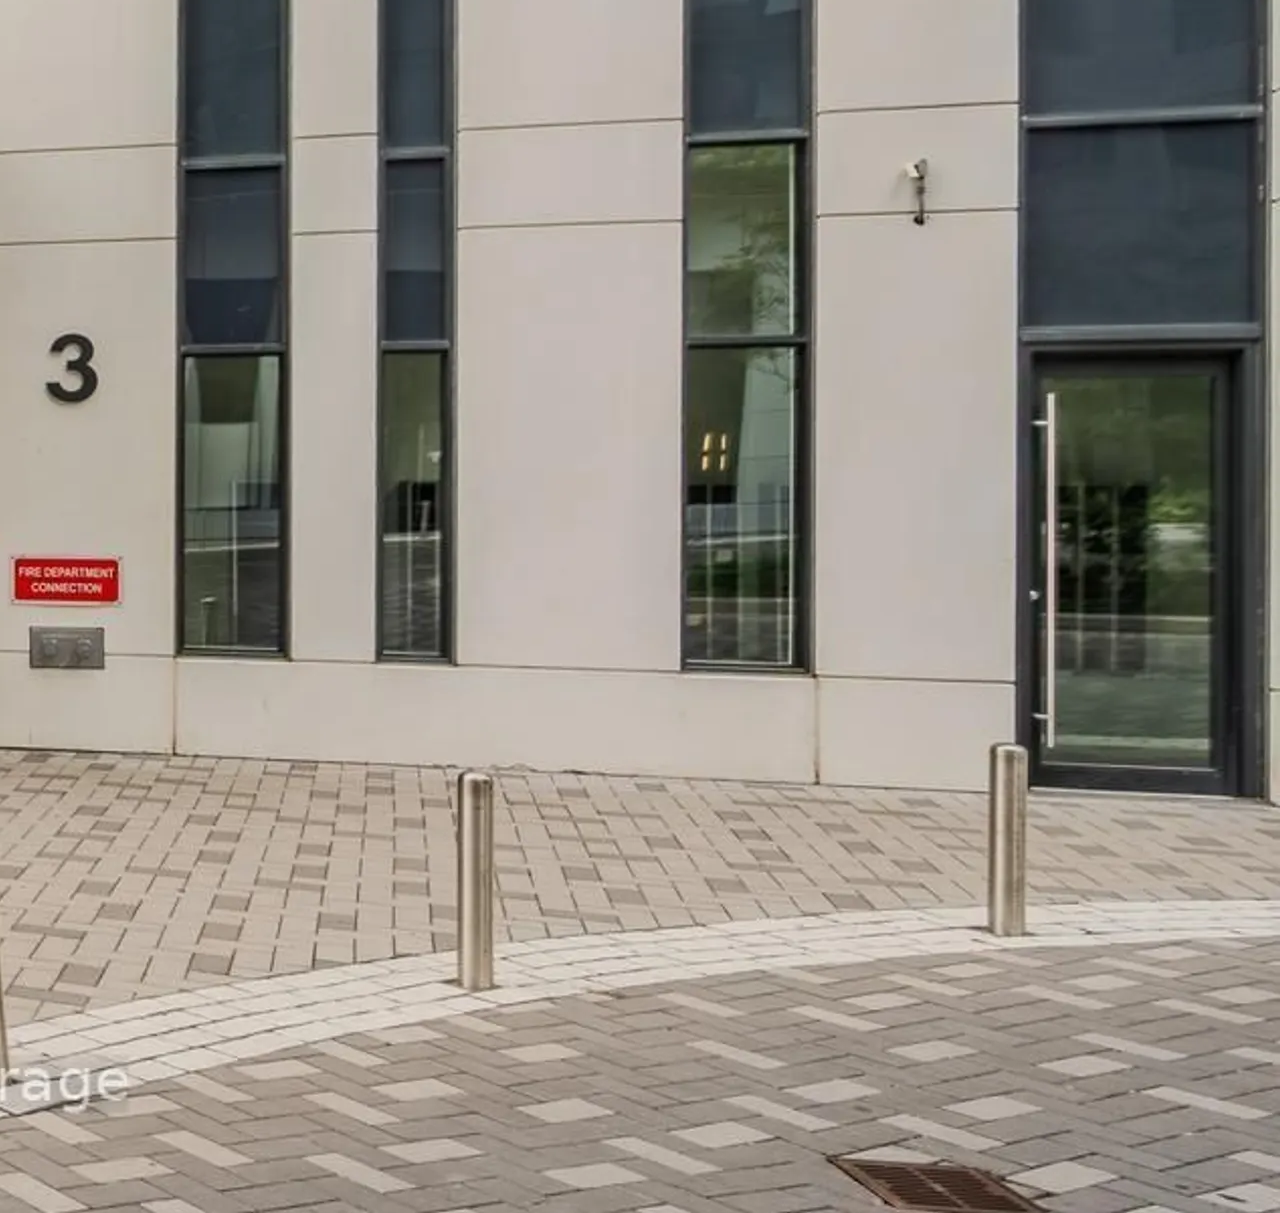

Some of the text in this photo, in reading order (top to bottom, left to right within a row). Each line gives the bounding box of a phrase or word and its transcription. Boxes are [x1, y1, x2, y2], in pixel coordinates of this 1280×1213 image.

[44, 333, 99, 404] 3
[18, 566, 114, 579] FIRE DEPARTMENT
[30, 582, 103, 594] CONNECTION
